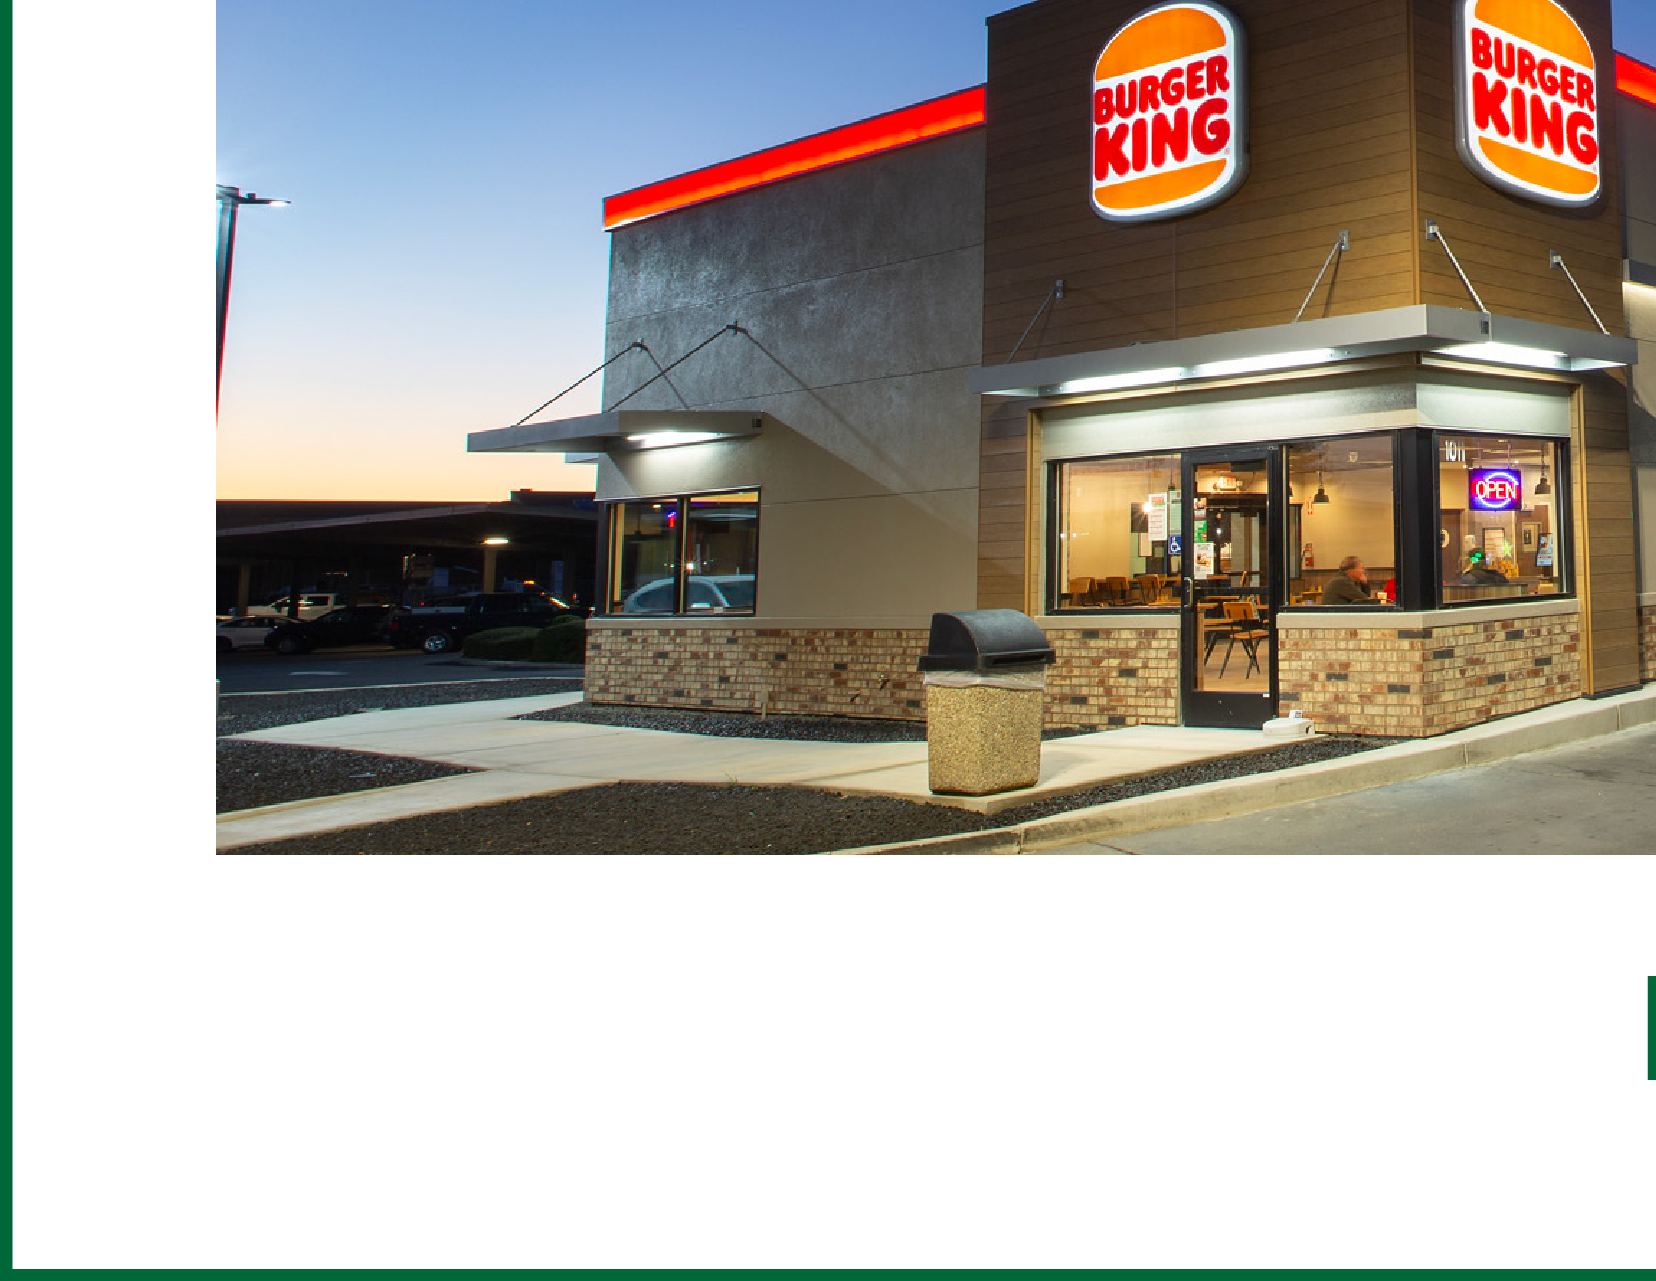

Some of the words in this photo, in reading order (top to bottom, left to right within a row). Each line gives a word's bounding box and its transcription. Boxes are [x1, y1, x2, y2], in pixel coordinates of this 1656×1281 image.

[1093, 55, 1230, 126] BURGER
[1471, 27, 1596, 113] BURGER
[1093, 97, 1231, 181] KING
[1473, 71, 1599, 166] KING
[1445, 439, 1466, 462] 1011
[1475, 480, 1517, 500] OPEN
